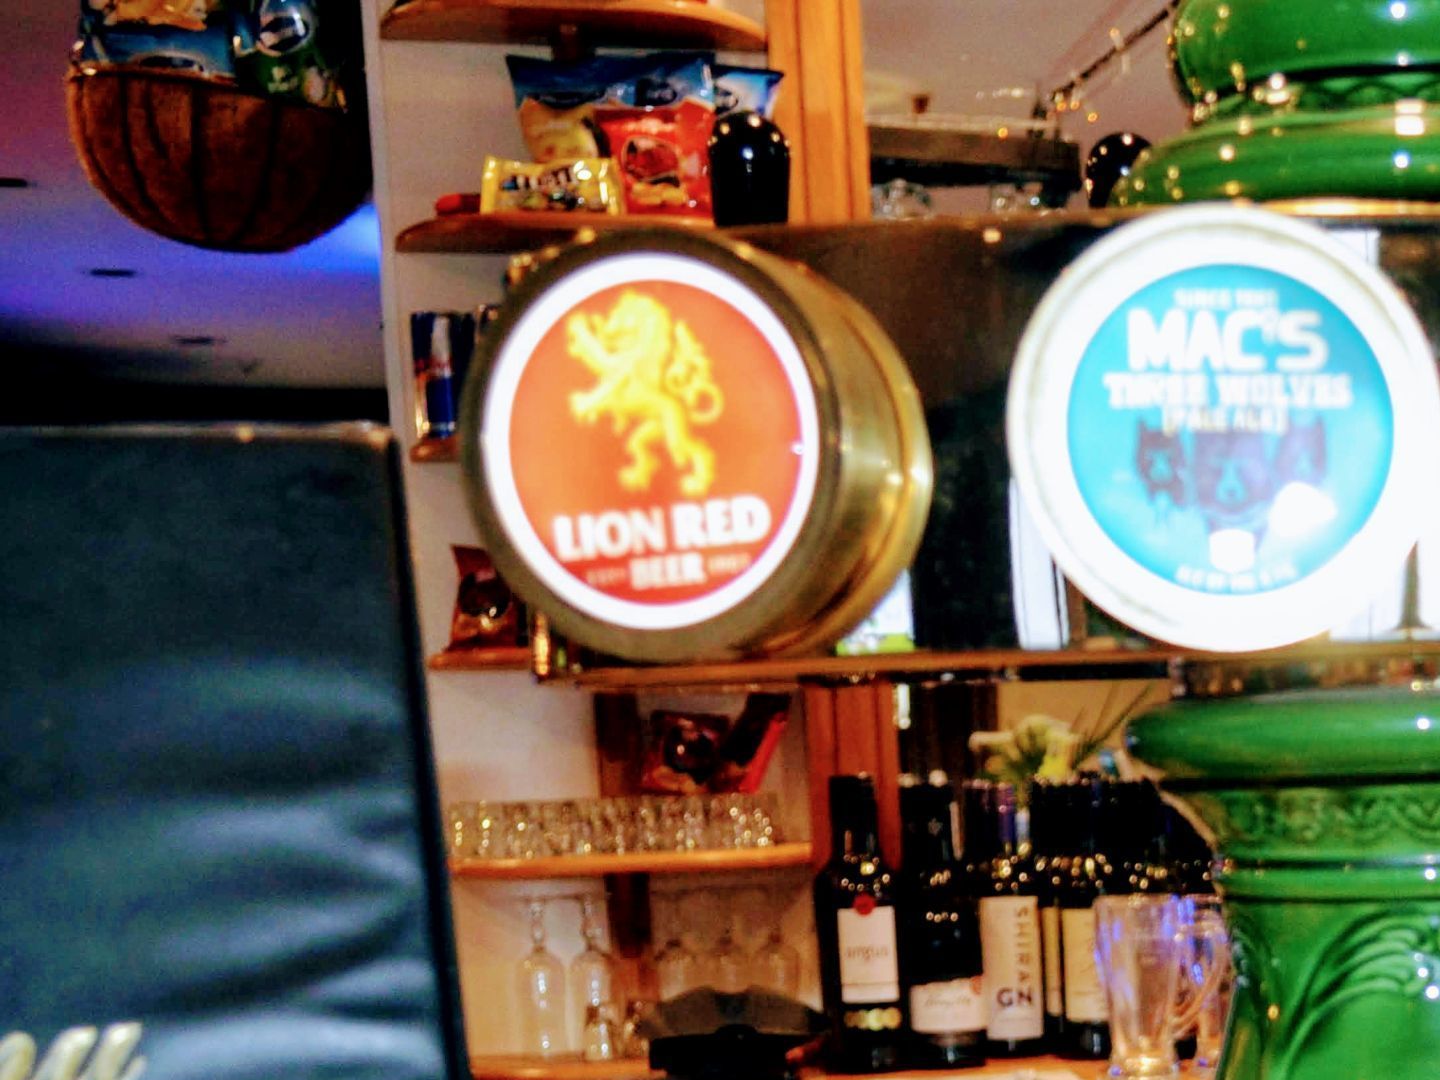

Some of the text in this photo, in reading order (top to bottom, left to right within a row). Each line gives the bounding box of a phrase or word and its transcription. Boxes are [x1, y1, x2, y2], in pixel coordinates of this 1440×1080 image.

[1127, 308, 1330, 371] MAC'S
[552, 507, 667, 563] LION
[671, 494, 773, 549] RED
